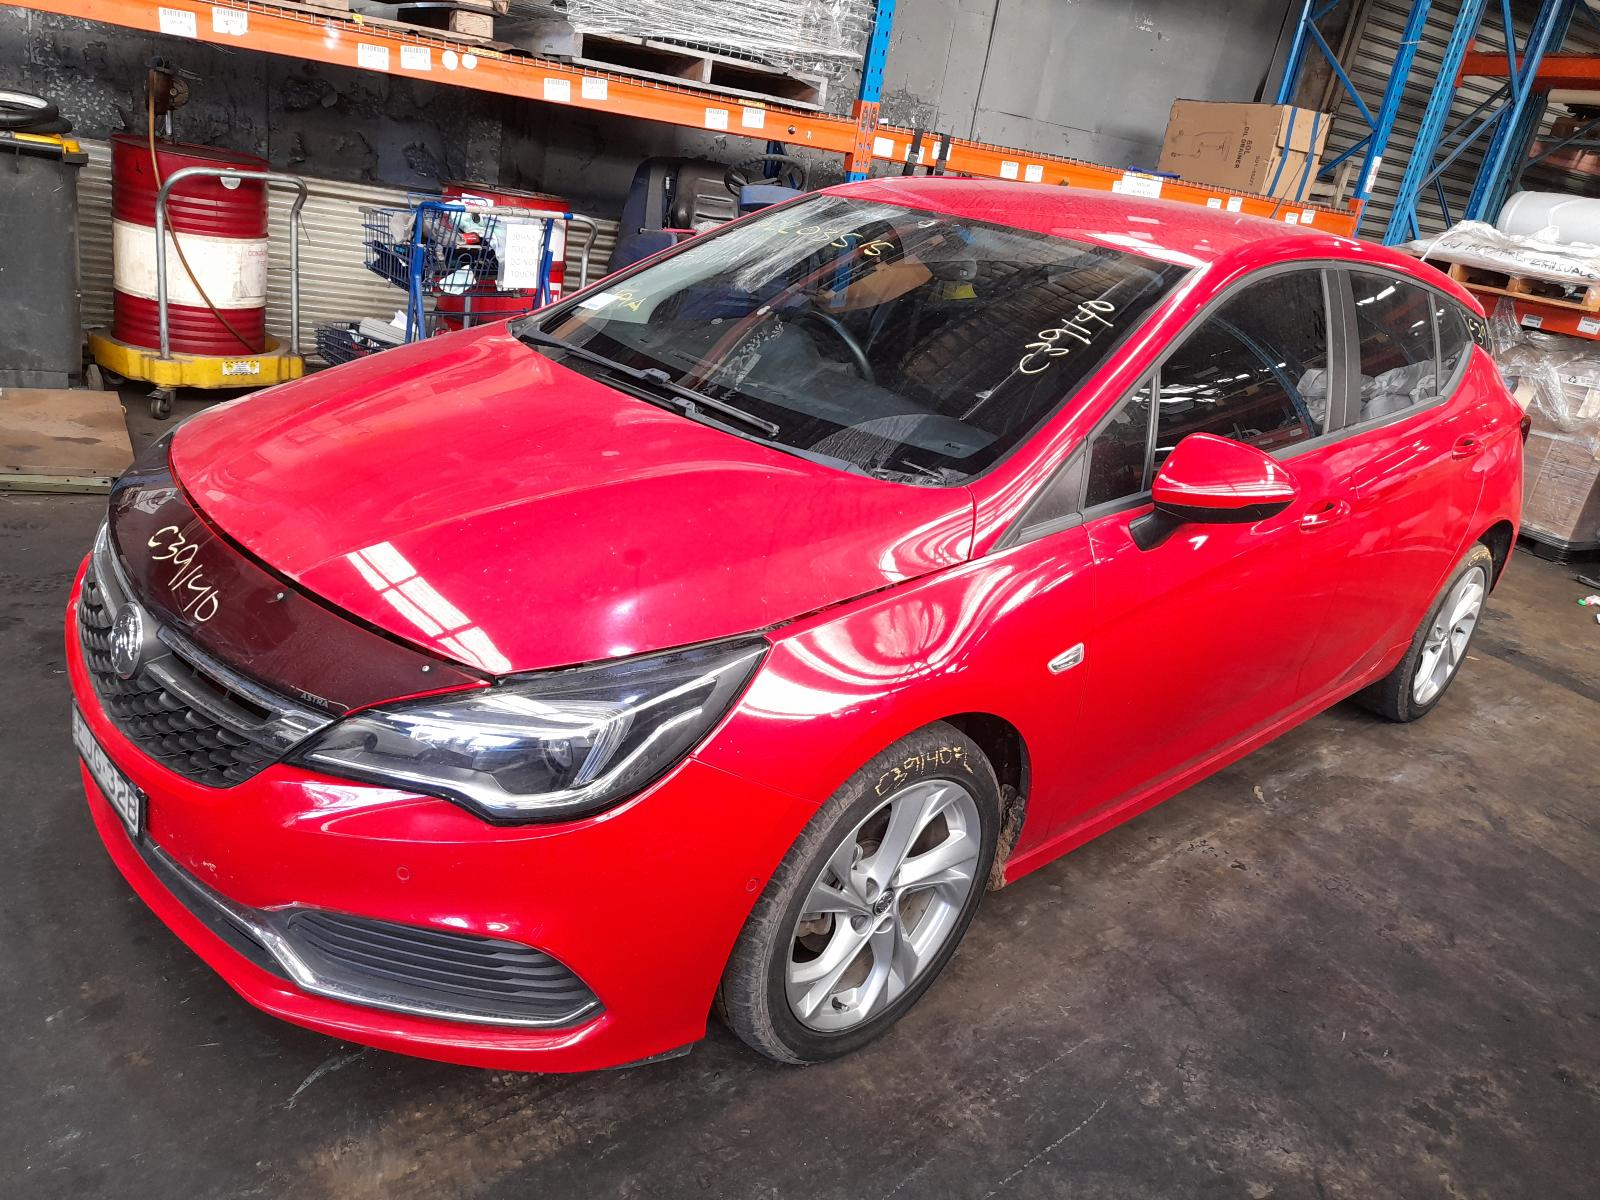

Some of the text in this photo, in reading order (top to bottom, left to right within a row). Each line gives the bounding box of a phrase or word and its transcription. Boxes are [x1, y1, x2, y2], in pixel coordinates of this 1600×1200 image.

[511, 270, 535, 279] TOUCH
[1020, 300, 1116, 375] C39140
[147, 525, 219, 622] C39140
[300, 692, 329, 709] ASTRA
